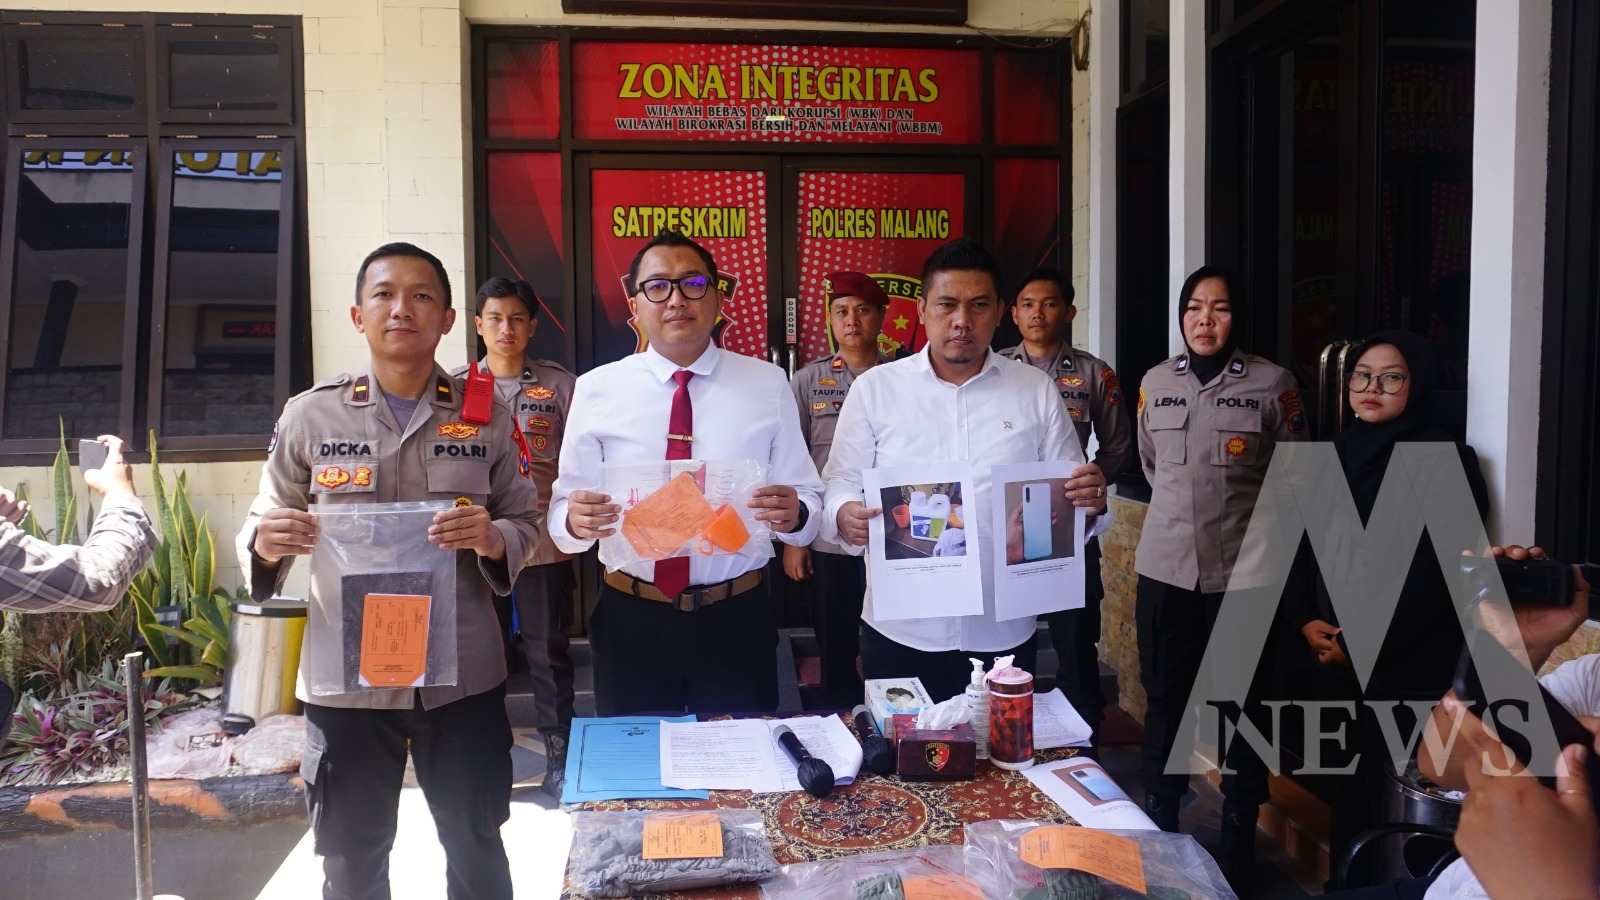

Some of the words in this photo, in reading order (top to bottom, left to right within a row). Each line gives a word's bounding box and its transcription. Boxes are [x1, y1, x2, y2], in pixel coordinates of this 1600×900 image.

[618, 63, 729, 99] ZONA
[741, 65, 939, 103] INTEGRITAS
[645, 105, 702, 117] WILAYAH
[708, 105, 747, 118] BEBAS
[751, 106, 782, 118] DARI
[787, 107, 840, 119] KORUPSI
[846, 108, 880, 120] (WBK)
[887, 109, 914, 120] DAN
[616, 118, 673, 131] WILAYAH
[678, 118, 746, 131] BIROKRASI
[751, 119, 794, 131] BERSIH
[799, 120, 825, 132] DAN
[831, 121, 891, 133] MELAYANI
[896, 122, 942, 135] (WBBM)
[612, 206, 747, 238] SATRESKRIM
[811, 208, 875, 239] POLRES
[881, 209, 949, 239] MALANG
[521, 403, 556, 413] POLRI
[1154, 397, 1187, 408] LEHA
[1216, 398, 1259, 409] POLRI
[320, 442, 371, 457] DICKA
[434, 444, 487, 458] POLRI
